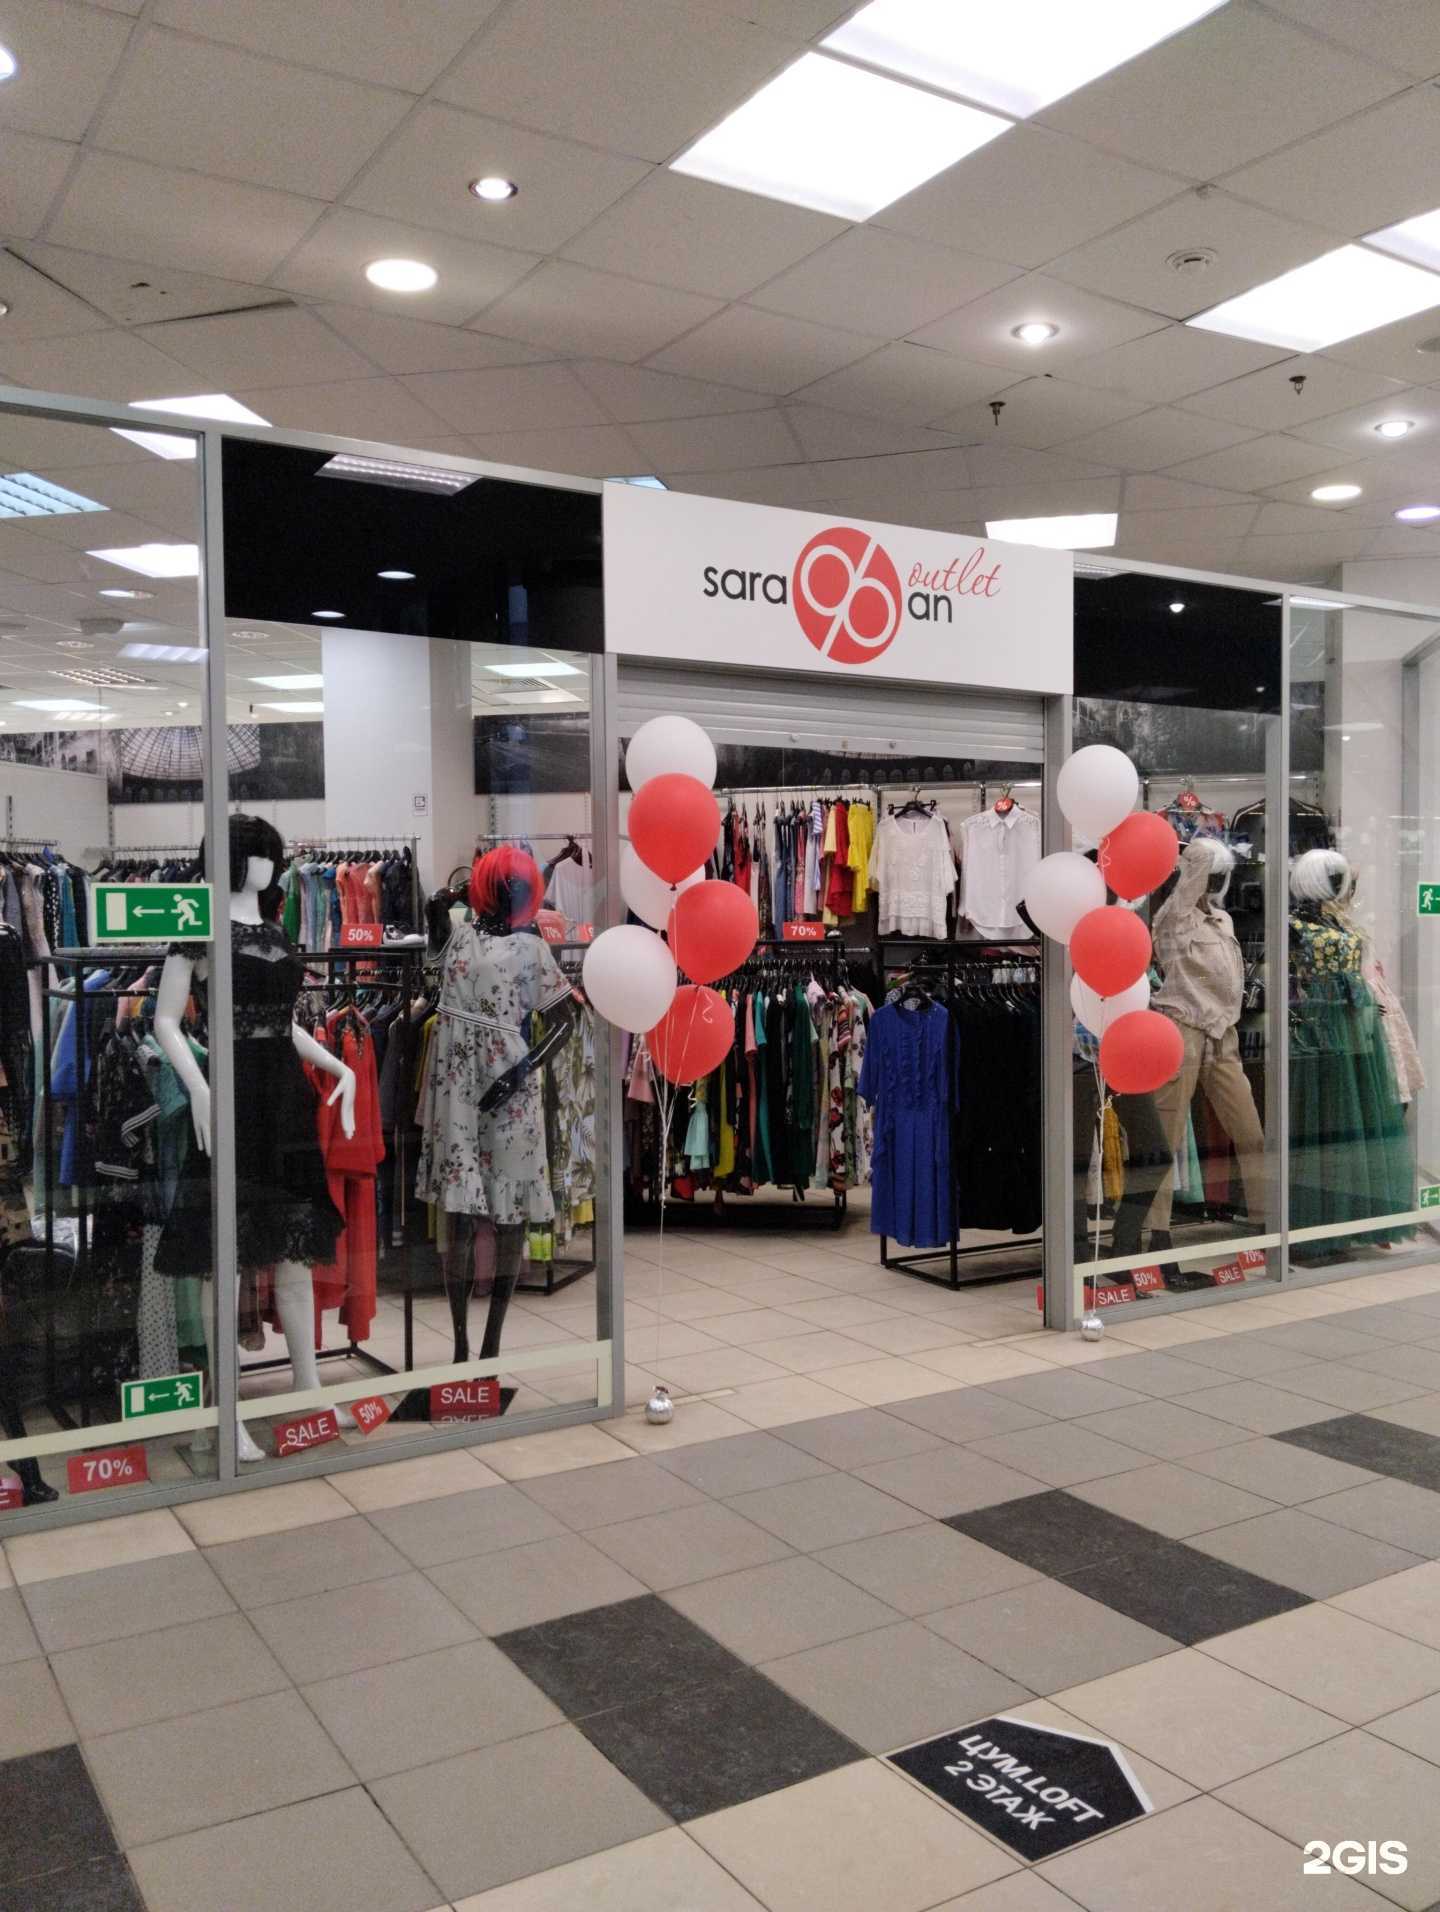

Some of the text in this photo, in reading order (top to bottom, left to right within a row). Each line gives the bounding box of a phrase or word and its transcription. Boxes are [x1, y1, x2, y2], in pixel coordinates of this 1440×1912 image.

[907, 547, 1002, 598] outlet
[703, 566, 787, 605] sara
[908, 590, 953, 623] an
[347, 928, 374, 941] 50%
[790, 925, 817, 937] 70%
[1133, 1271, 1157, 1287] 50%
[1218, 1266, 1241, 1284] SALE
[1098, 1289, 1130, 1305] SALE
[440, 1386, 490, 1404] SALE
[359, 1402, 383, 1425] 50%
[285, 1417, 331, 1446] SALE
[82, 1458, 133, 1482] 70%
[958, 1734, 1105, 1823] ЦУМ.LOFT
[943, 1760, 1057, 1831] 2 ЭТАЖ
